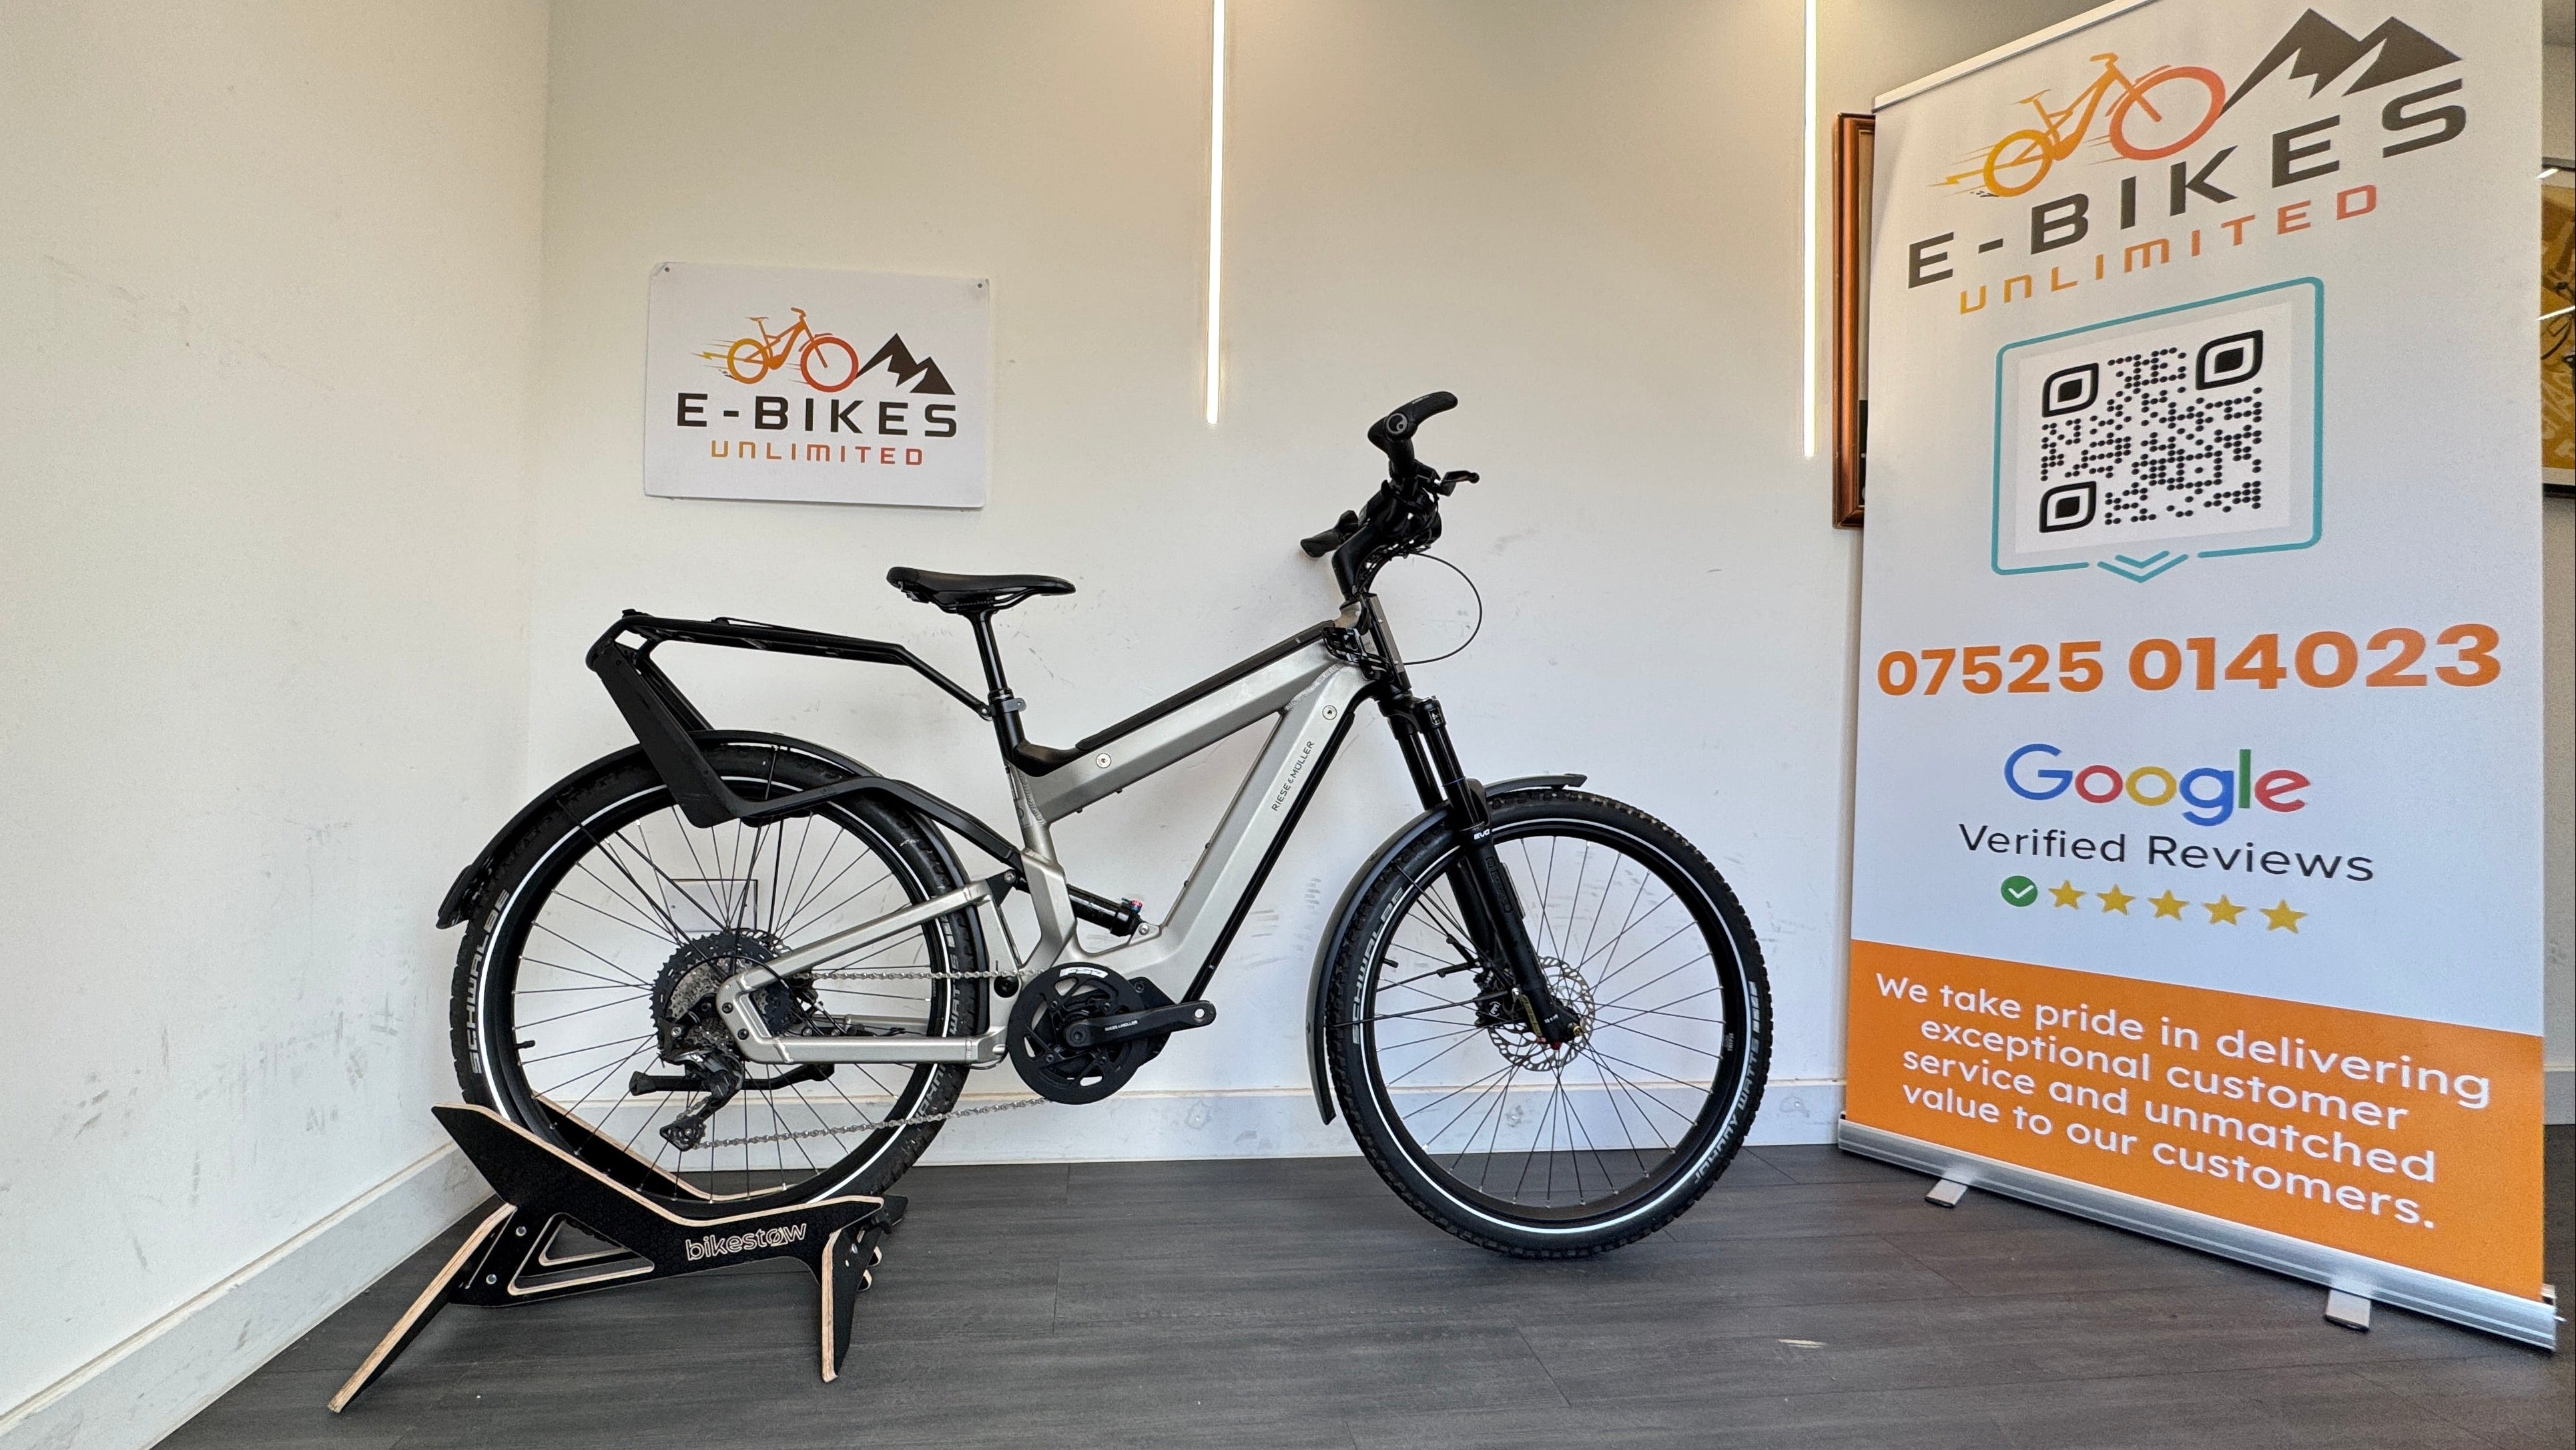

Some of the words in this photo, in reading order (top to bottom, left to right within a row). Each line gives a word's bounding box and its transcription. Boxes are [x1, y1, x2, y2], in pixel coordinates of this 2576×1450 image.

[1908, 78, 2467, 289] E-BIKES
[1959, 184, 2377, 314] UNLIMITED
[677, 393, 958, 438] E-BIKES
[711, 440, 923, 466] UNLIMITED
[1878, 641, 2103, 696] 07525
[2130, 624, 2500, 690] 014023
[1474, 828, 1490, 840] EVO
[2003, 743, 2309, 828] Google
[1959, 823, 2126, 863] Verified
[2148, 835, 2374, 882] Reviews
[466, 889, 510, 1074] SCHWALBE
[948, 954, 960, 1035] WATS
[1876, 973, 1928, 1003] We
[1939, 985, 2021, 1019] take
[2035, 1004, 2144, 1040] pride
[2161, 1016, 2199, 1051] in
[2216, 1029, 2491, 1110] delivering
[1921, 1020, 2150, 1081] exceptional
[2166, 1066, 2410, 1130] customer
[1903, 1051, 2035, 1095] service
[2049, 1081, 2128, 1116] and
[2145, 1100, 2436, 1183] unmatched
[1903, 1084, 2000, 1123] value
[2012, 1106, 2053, 1136] to
[2066, 1123, 2138, 1155] our
[2152, 1142, 2435, 1229] customers.
